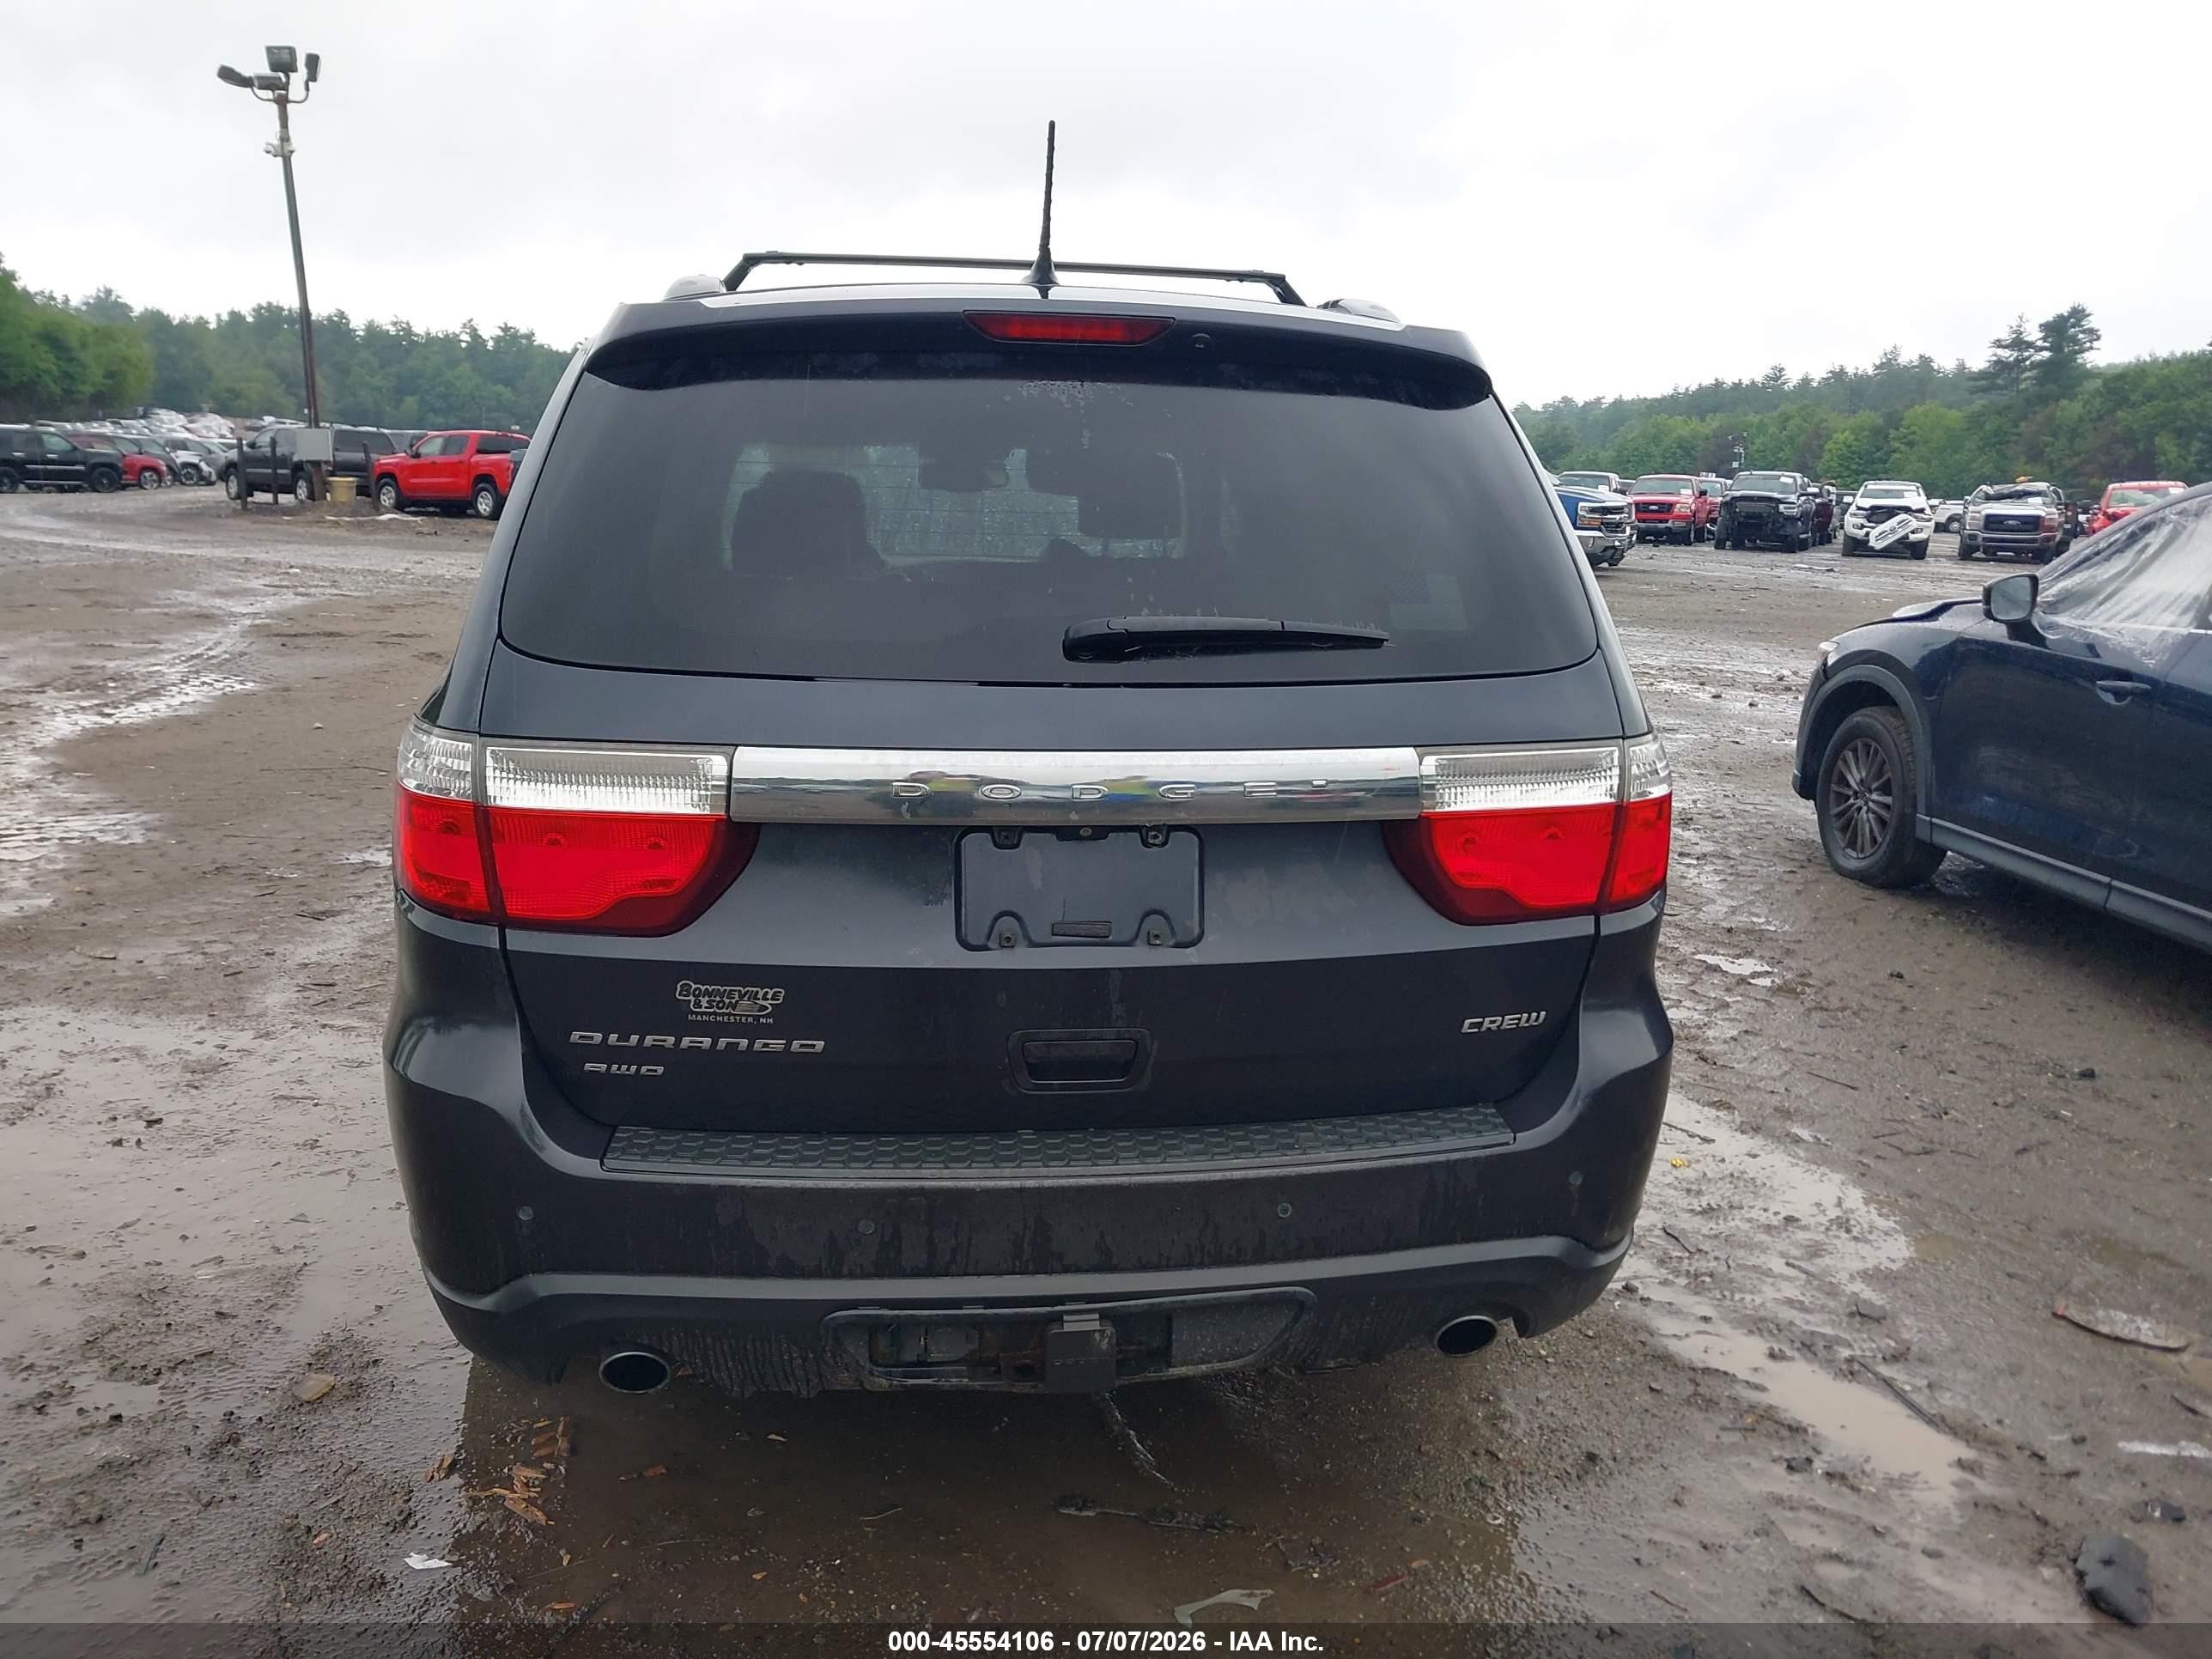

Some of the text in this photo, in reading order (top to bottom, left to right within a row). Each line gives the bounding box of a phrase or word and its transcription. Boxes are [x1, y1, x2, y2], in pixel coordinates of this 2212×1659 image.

[891, 781, 1278, 800] DODGE
[677, 981, 785, 1004] BONNEVILLE
[691, 998, 739, 1012] & SON
[687, 1014, 757, 1024] MANCHESTER,
[1461, 1011, 1547, 1033] CREW
[568, 1031, 825, 1053] DURANGO
[583, 1062, 665, 1076] AWD
